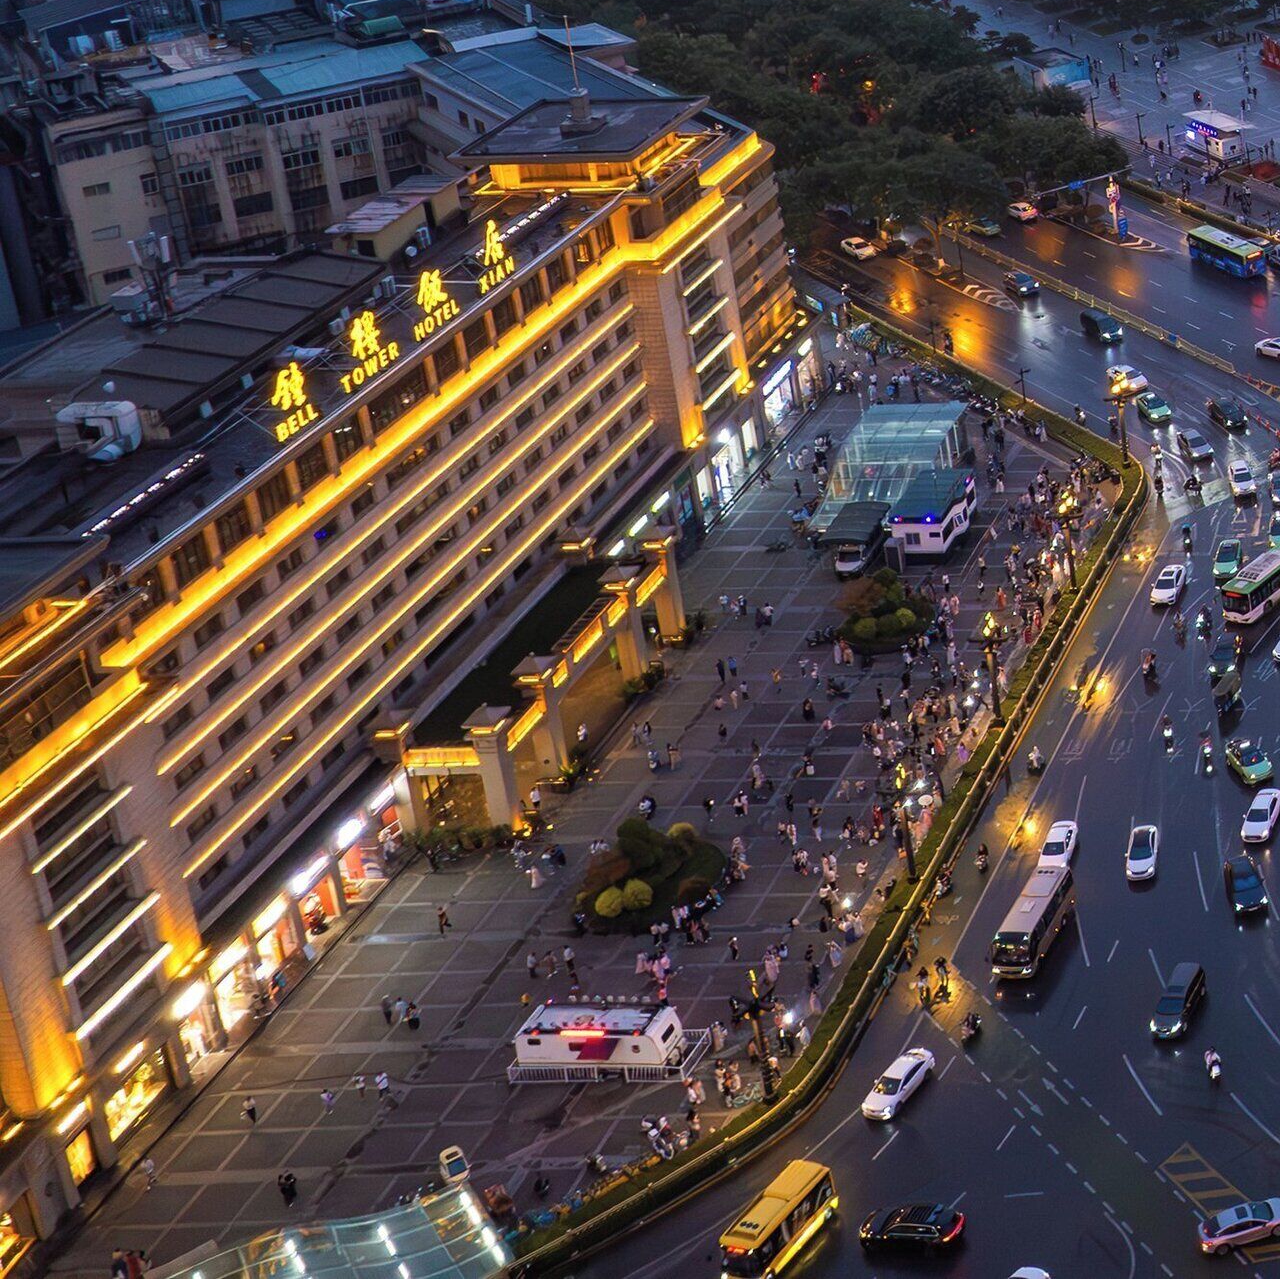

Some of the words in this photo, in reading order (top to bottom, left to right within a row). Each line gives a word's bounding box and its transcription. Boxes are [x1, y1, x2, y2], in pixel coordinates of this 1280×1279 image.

[274, 403, 319, 442] BELL
[340, 341, 400, 394] TOWER
[413, 299, 461, 342] HOTEL
[477, 256, 515, 295] XIAN
